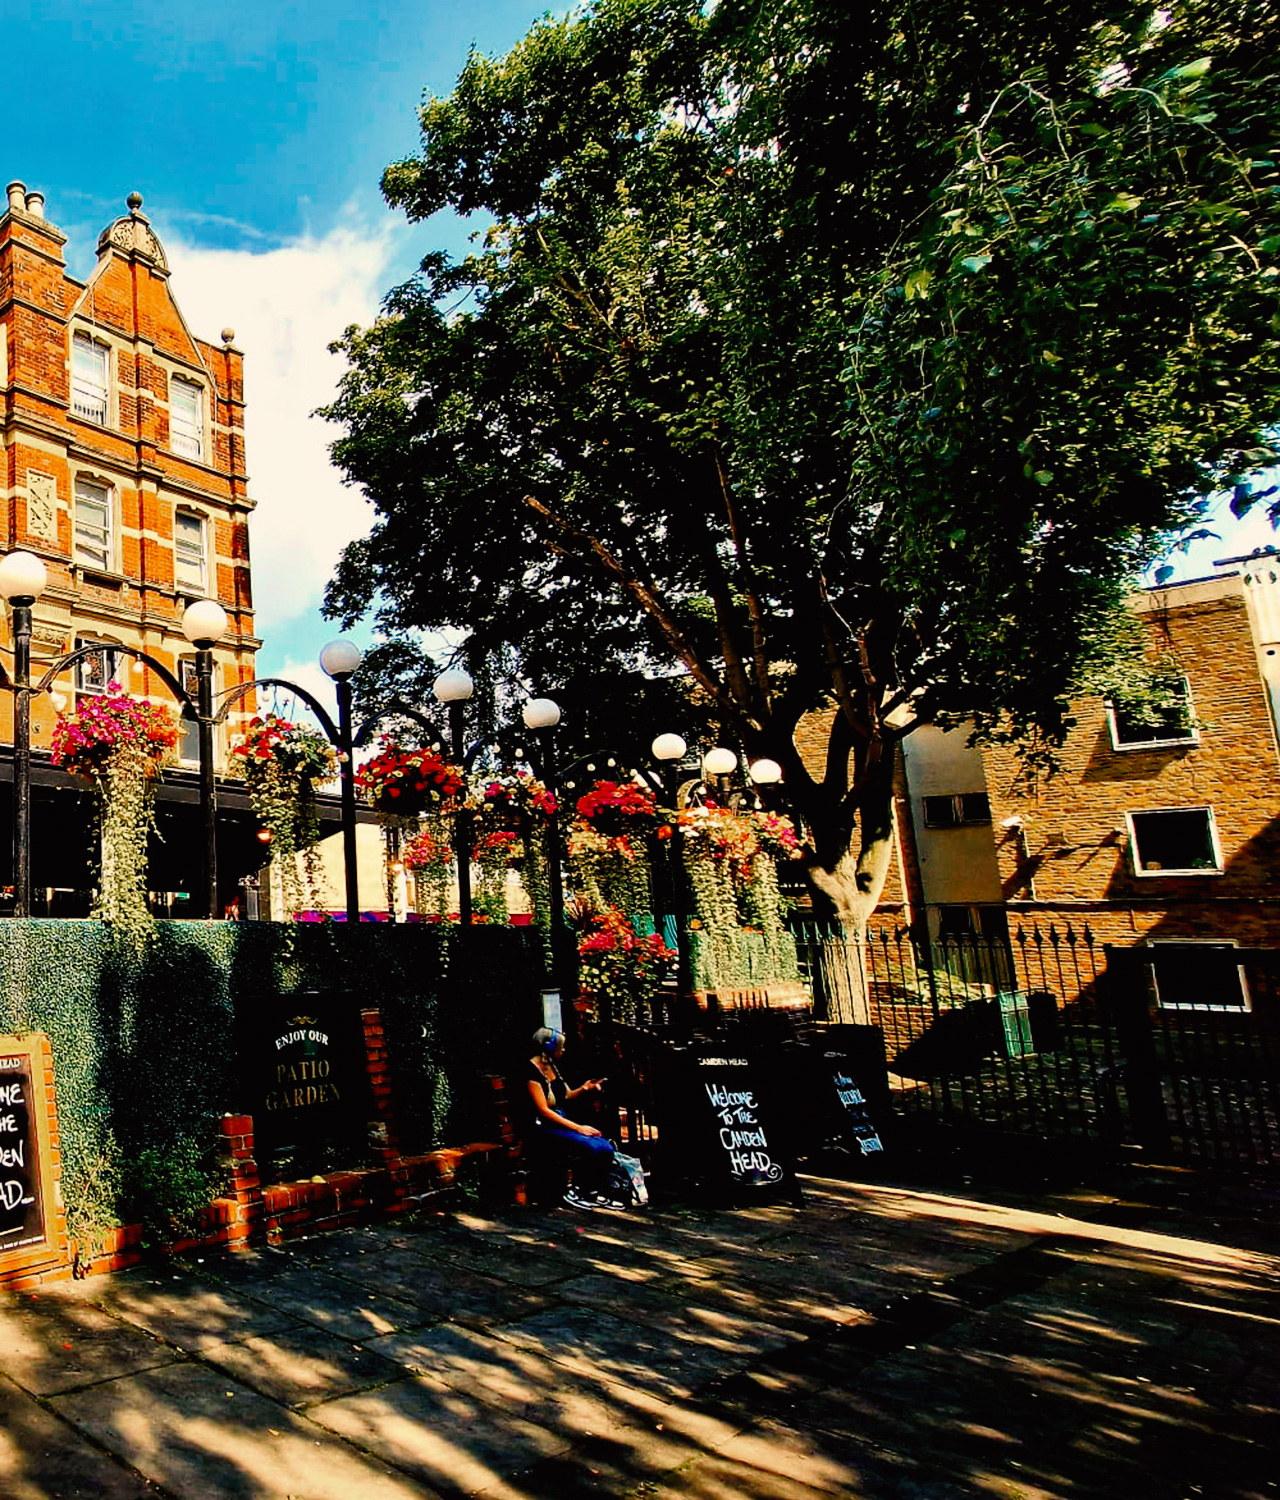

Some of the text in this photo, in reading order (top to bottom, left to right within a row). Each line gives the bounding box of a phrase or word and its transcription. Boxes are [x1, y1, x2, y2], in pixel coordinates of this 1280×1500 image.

[274, 1029, 329, 1050] ENJOY OUR
[276, 1059, 330, 1083] PATIO
[265, 1083, 340, 1111] GARDEN
[729, 1150, 771, 1176] HEAD
